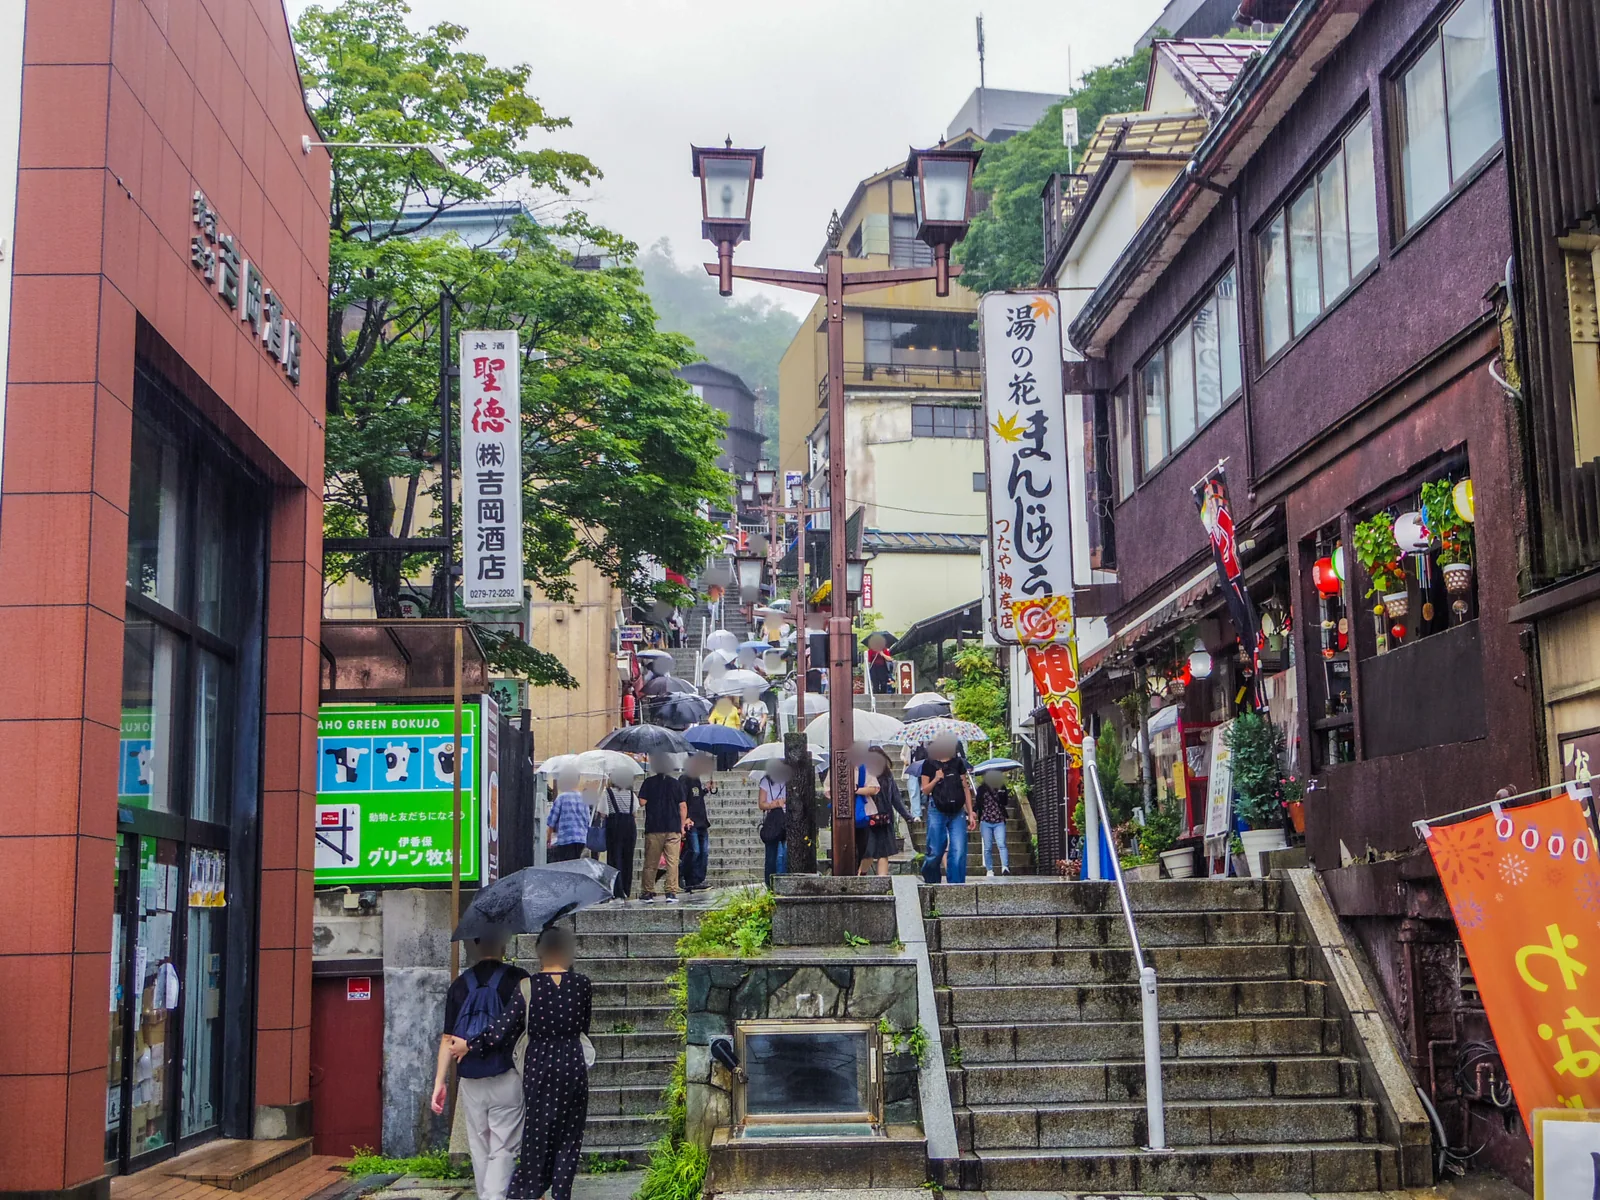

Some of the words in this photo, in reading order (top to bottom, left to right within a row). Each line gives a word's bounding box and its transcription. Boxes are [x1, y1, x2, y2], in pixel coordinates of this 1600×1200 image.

[218, 233, 301, 387] 吉岡酒店
[474, 342, 505, 350] 地酒
[1005, 305, 1055, 598] 湯の花まんじゅう
[995, 518, 1014, 630] つたや物産店
[470, 589, 515, 599] 0279-72-2292
[347, 719, 386, 730] GREEN
[398, 836, 433, 847] 伊香保
